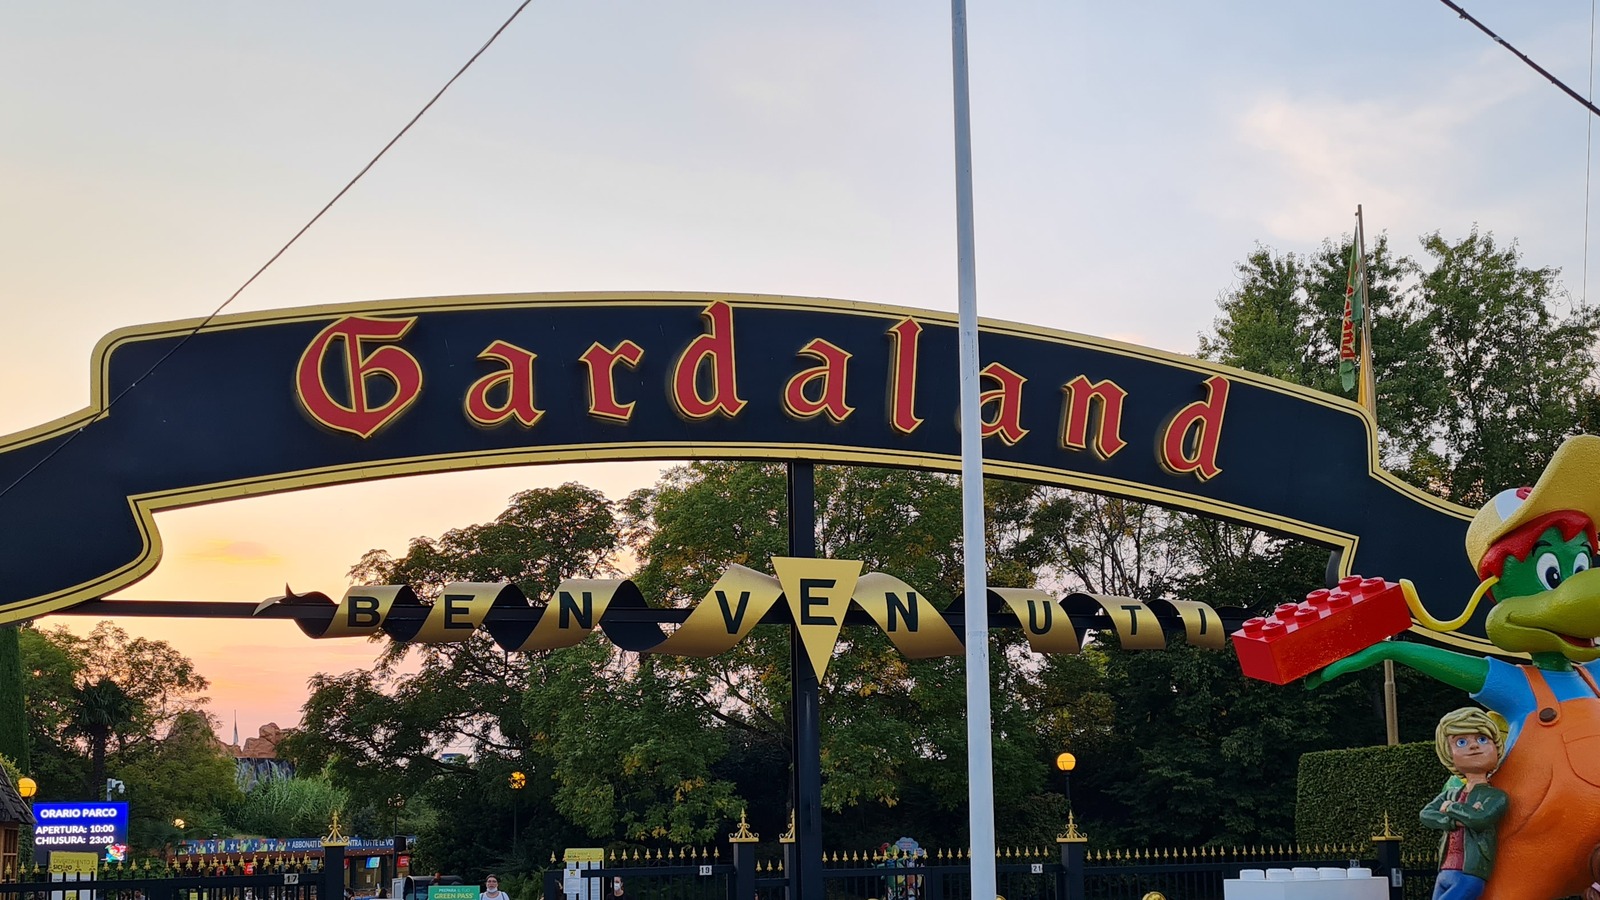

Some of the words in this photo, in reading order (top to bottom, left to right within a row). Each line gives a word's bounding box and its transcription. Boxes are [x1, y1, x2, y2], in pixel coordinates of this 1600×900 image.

[295, 299, 1230, 482] Gardaland
[40, 808, 80, 818] ORARIO
[82, 808, 117, 817] PARCO
[35, 825, 87, 834] APERTURA:
[90, 824, 114, 833] 10:00
[35, 836, 86, 845] CHIUSURA:
[89, 836, 114, 844] 23:00
[286, 875, 298, 883] 17
